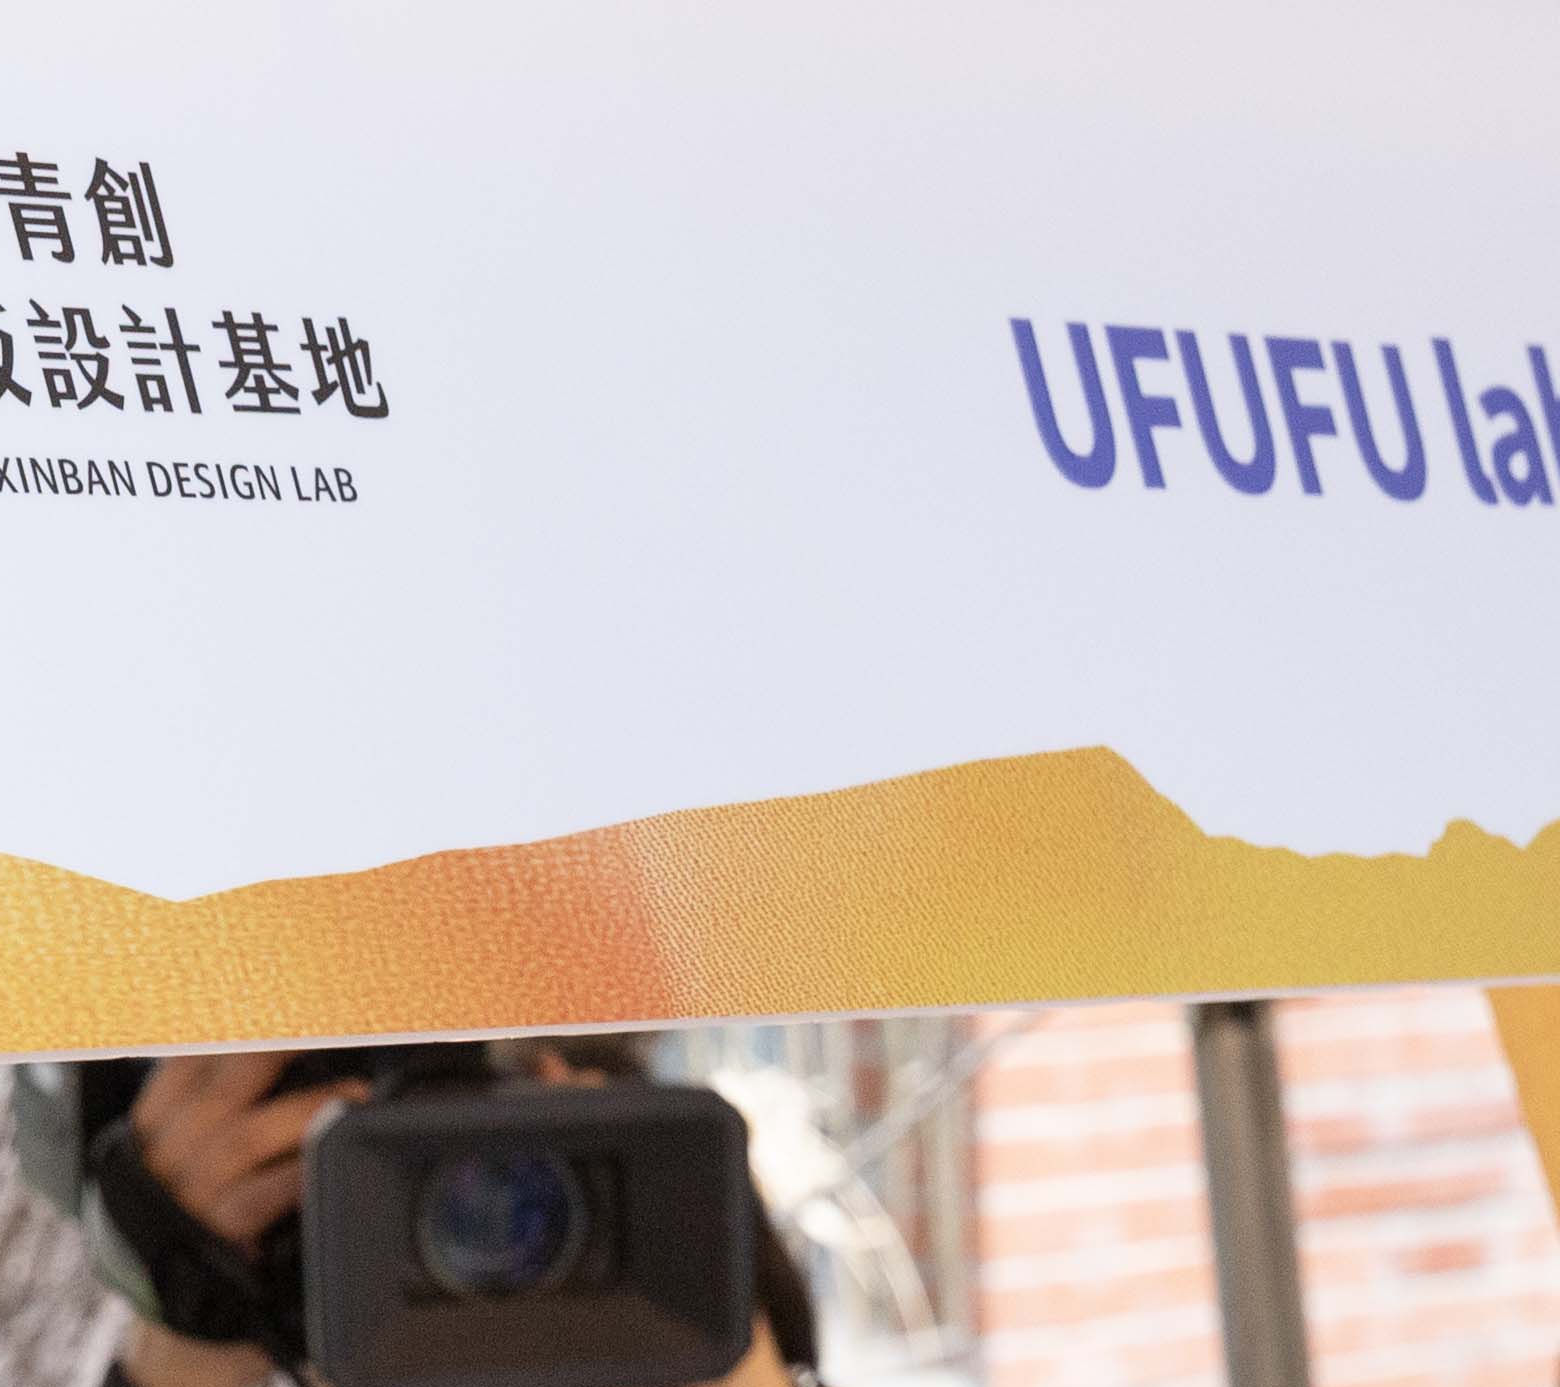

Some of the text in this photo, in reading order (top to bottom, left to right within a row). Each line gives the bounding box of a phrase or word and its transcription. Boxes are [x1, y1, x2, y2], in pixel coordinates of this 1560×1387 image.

[1009, 318, 1428, 502] UFUFU
[146, 461, 282, 501] DESIGN
[290, 466, 359, 503] LAB
